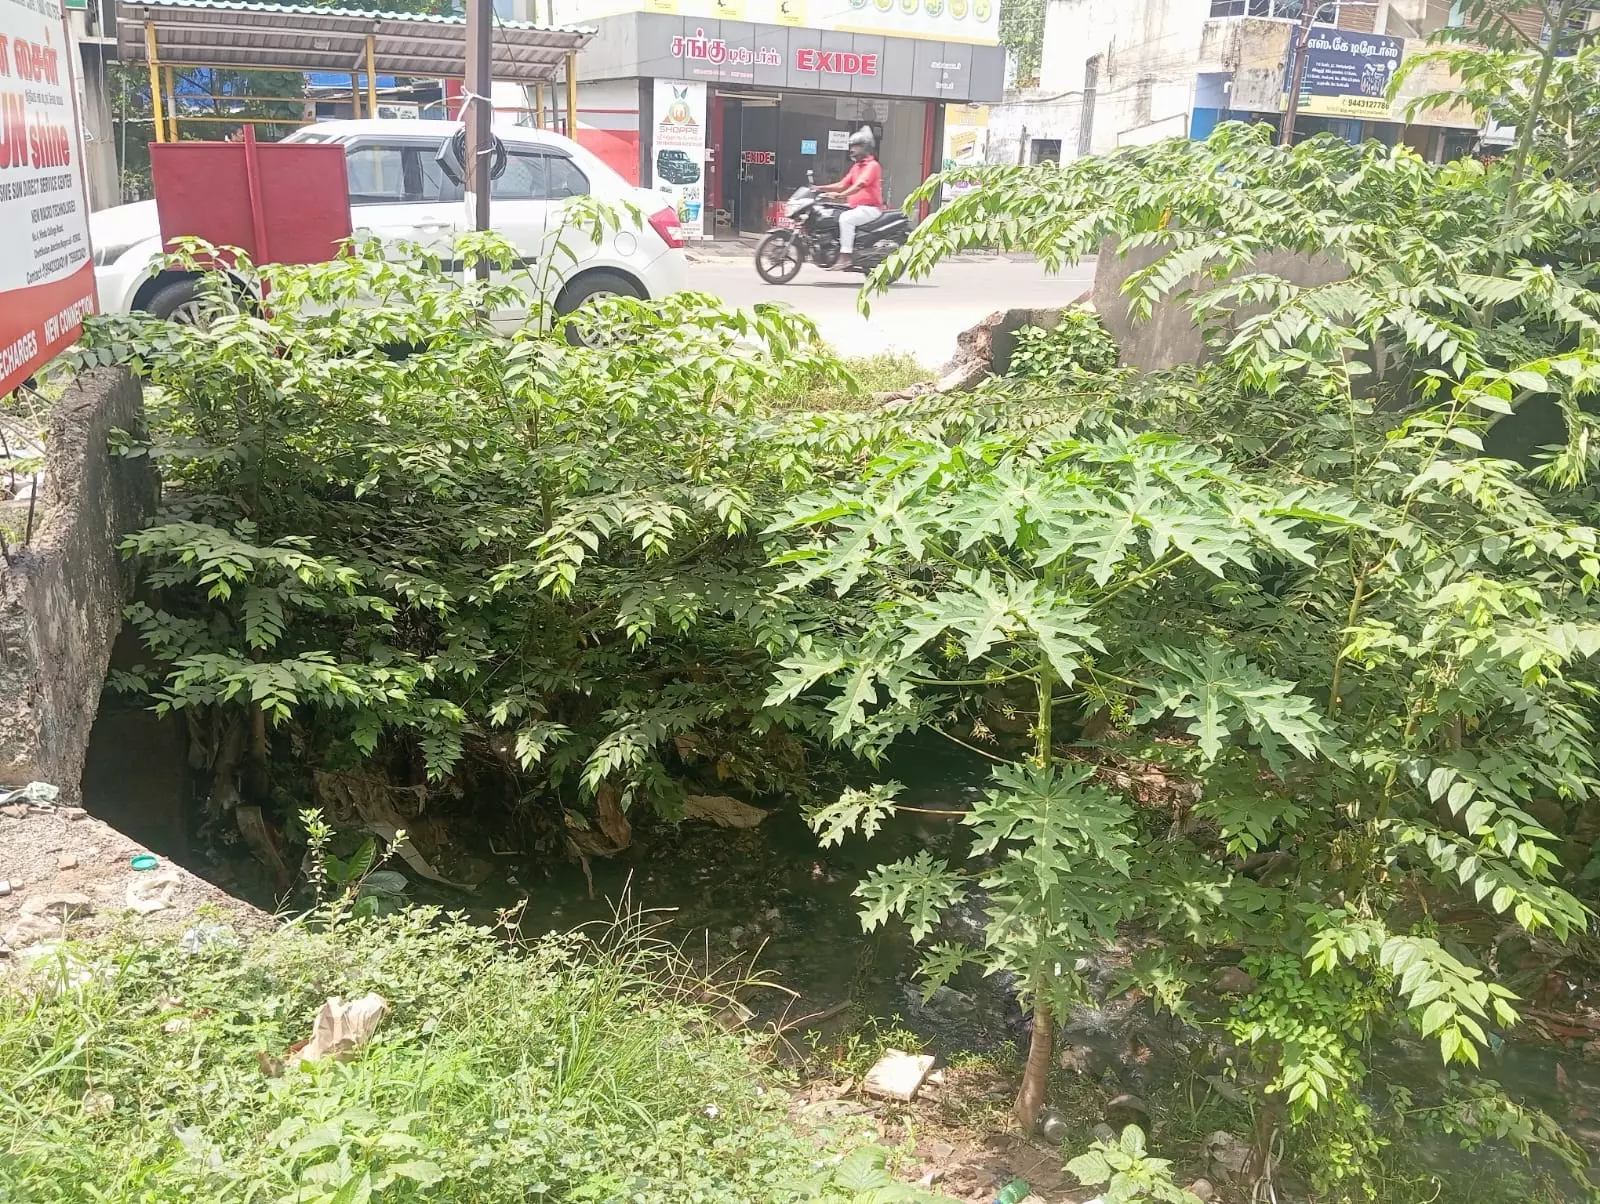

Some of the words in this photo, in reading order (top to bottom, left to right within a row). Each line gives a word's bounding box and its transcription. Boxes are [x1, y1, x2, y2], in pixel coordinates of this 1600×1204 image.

[671, 27, 726, 64] சங்கு
[796, 49, 877, 76] EXIDE
[30, 110, 70, 169] shine
[659, 126, 699, 135] SHOPPE
[745, 152, 770, 163] EXIDE
[12, 181, 23, 199] SUN
[23, 178, 40, 197] DIRECT
[40, 175, 57, 194] SERVICE
[57, 173, 73, 190] CENTER
[44, 314, 60, 346] NEW
[60, 293, 95, 335] CONNECTION
